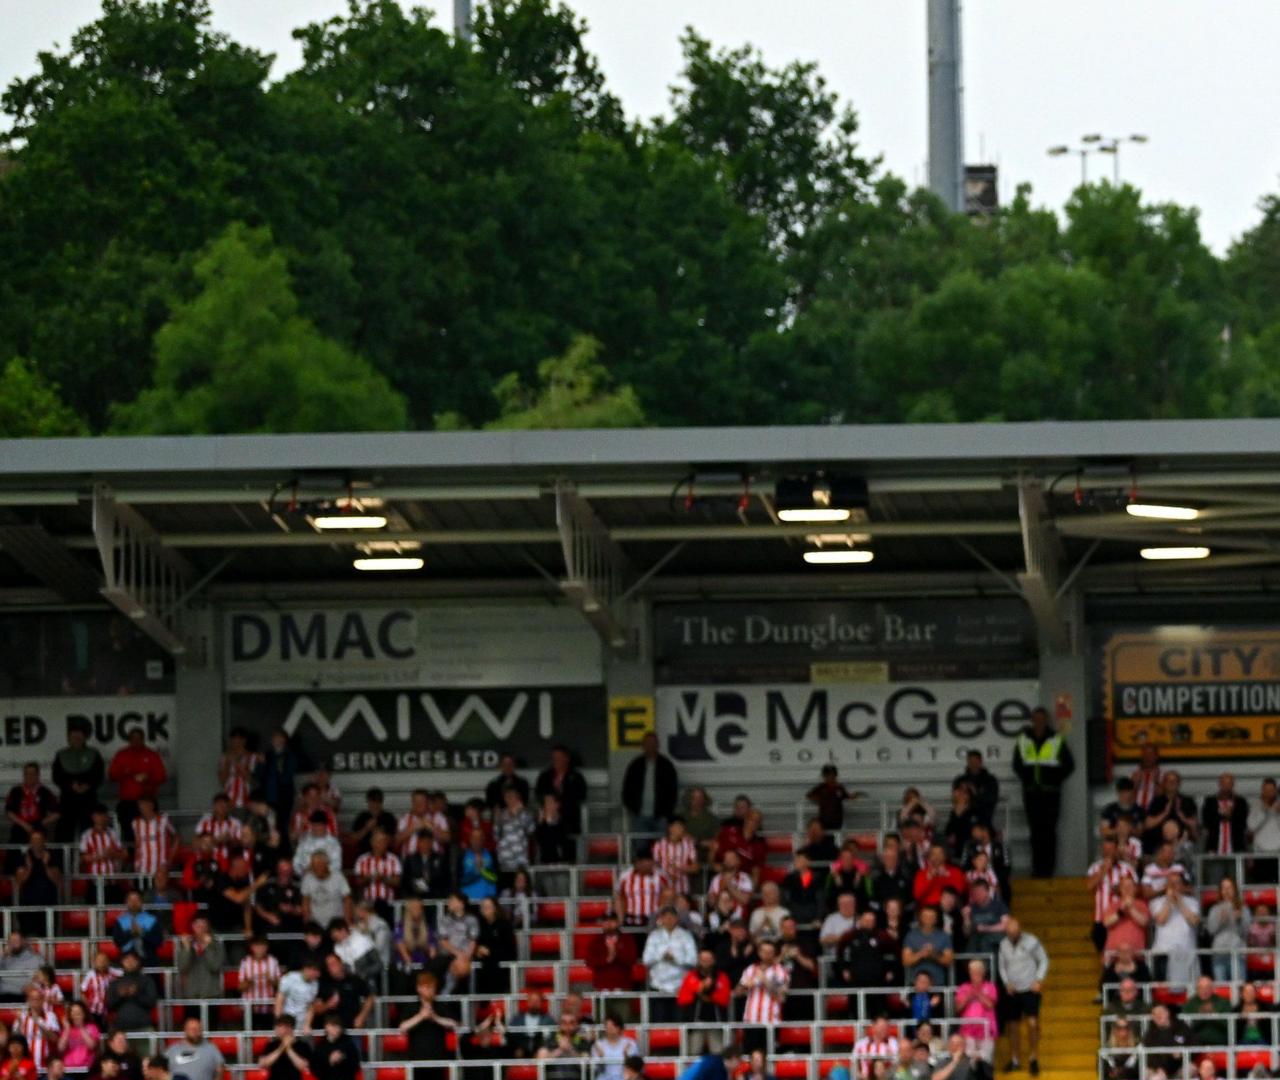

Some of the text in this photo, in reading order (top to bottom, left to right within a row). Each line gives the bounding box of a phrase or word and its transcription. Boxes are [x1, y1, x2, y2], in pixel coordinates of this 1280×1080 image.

[232, 611, 416, 663] DMAC
[675, 613, 937, 651] The Dungloe Bar
[1158, 648, 1260, 677] CITY
[283, 692, 553, 742] MIWI
[617, 704, 647, 747] E
[766, 686, 1033, 743] McGee
[333, 751, 498, 770] SERVICES LTD
[768, 745, 1000, 764] SOLICITOR
